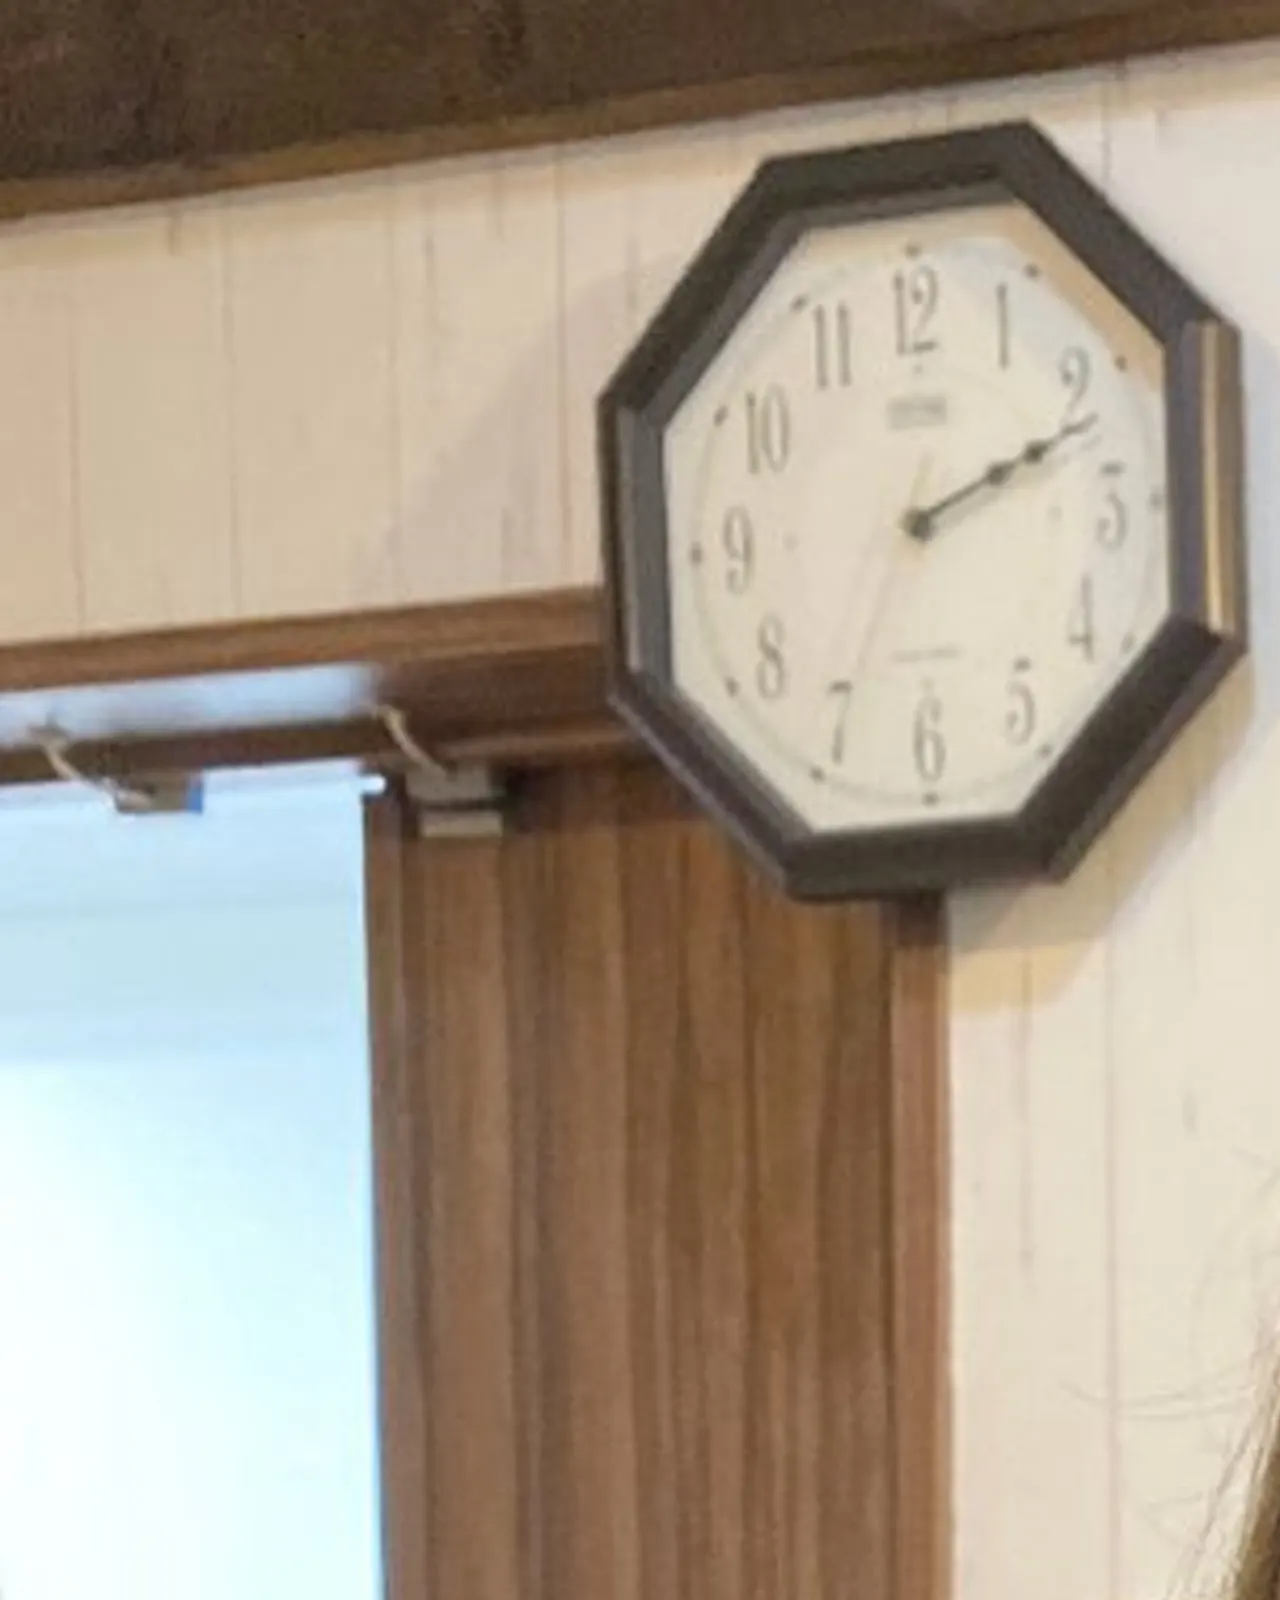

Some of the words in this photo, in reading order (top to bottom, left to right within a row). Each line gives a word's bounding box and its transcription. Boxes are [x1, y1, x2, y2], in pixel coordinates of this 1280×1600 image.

[812, 299, 852, 391] 11
[892, 264, 939, 357] 12
[995, 279, 1012, 373] 1
[745, 381, 791, 475] 10
[1056, 343, 1094, 440] 2
[722, 503, 755, 594] 9
[1097, 459, 1128, 549] 3
[756, 612, 785, 700] 8
[1066, 568, 1095, 664] 4
[825, 679, 853, 766] 7
[912, 695, 946, 783] 6
[1003, 657, 1037, 746] 5
